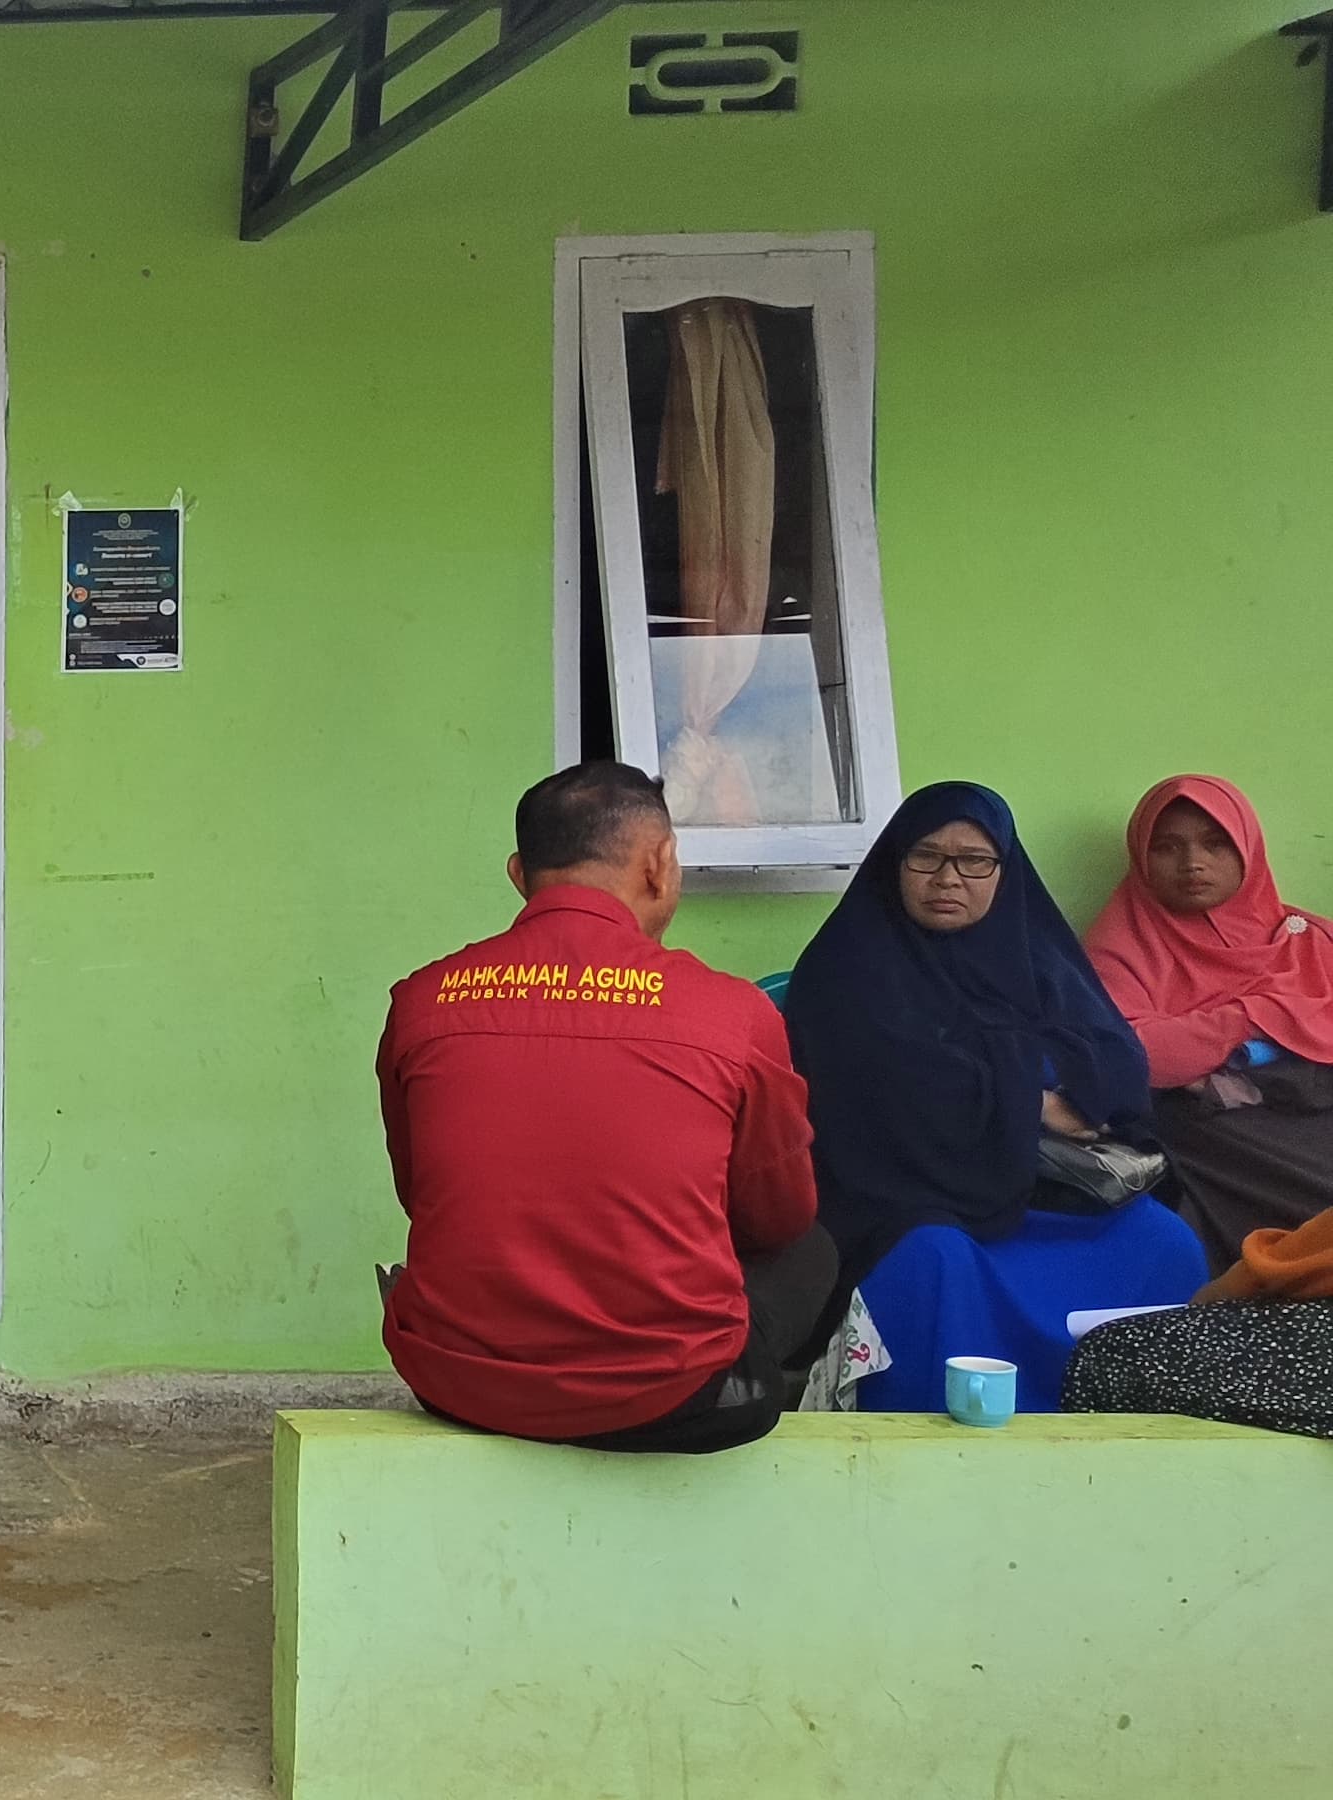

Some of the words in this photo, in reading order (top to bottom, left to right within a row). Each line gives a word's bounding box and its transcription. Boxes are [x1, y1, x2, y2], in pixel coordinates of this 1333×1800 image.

[440, 963, 569, 991] MAHKAMAH
[578, 964, 666, 994] AGUNG
[435, 986, 529, 1004] REPUBLIK
[542, 988, 663, 1007] INDONESIA
